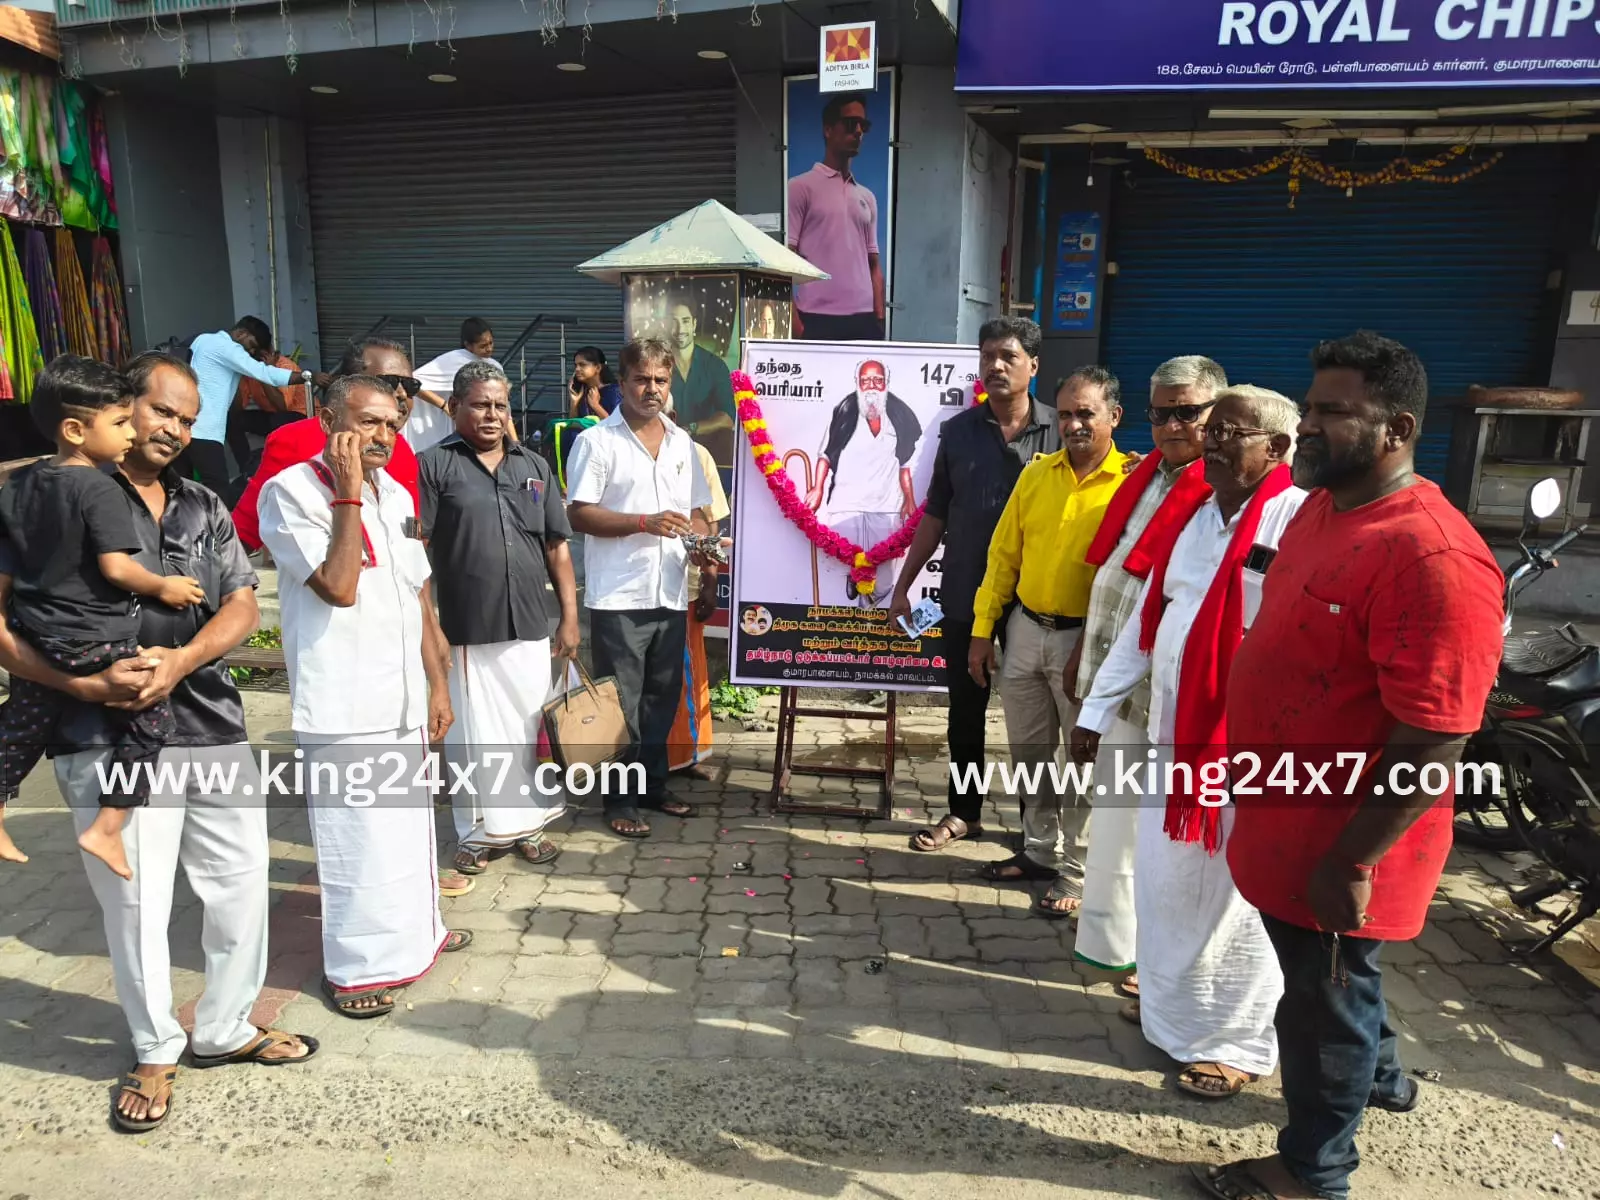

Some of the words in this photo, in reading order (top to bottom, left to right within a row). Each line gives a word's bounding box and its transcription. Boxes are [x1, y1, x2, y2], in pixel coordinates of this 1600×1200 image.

[1218, 0, 1410, 45] ROYAL
[1434, 0, 1600, 41] CHIP
[826, 64, 849, 72] ADITYA
[850, 63, 870, 71] BIRLA
[1226, 62, 1275, 74] மெயின்
[755, 357, 803, 376] தந்தை
[920, 362, 955, 385] 147
[755, 379, 824, 398] பெரியார்
[802, 636, 841, 650] மற்றும்
[746, 647, 793, 663] தமிழ்நாடு
